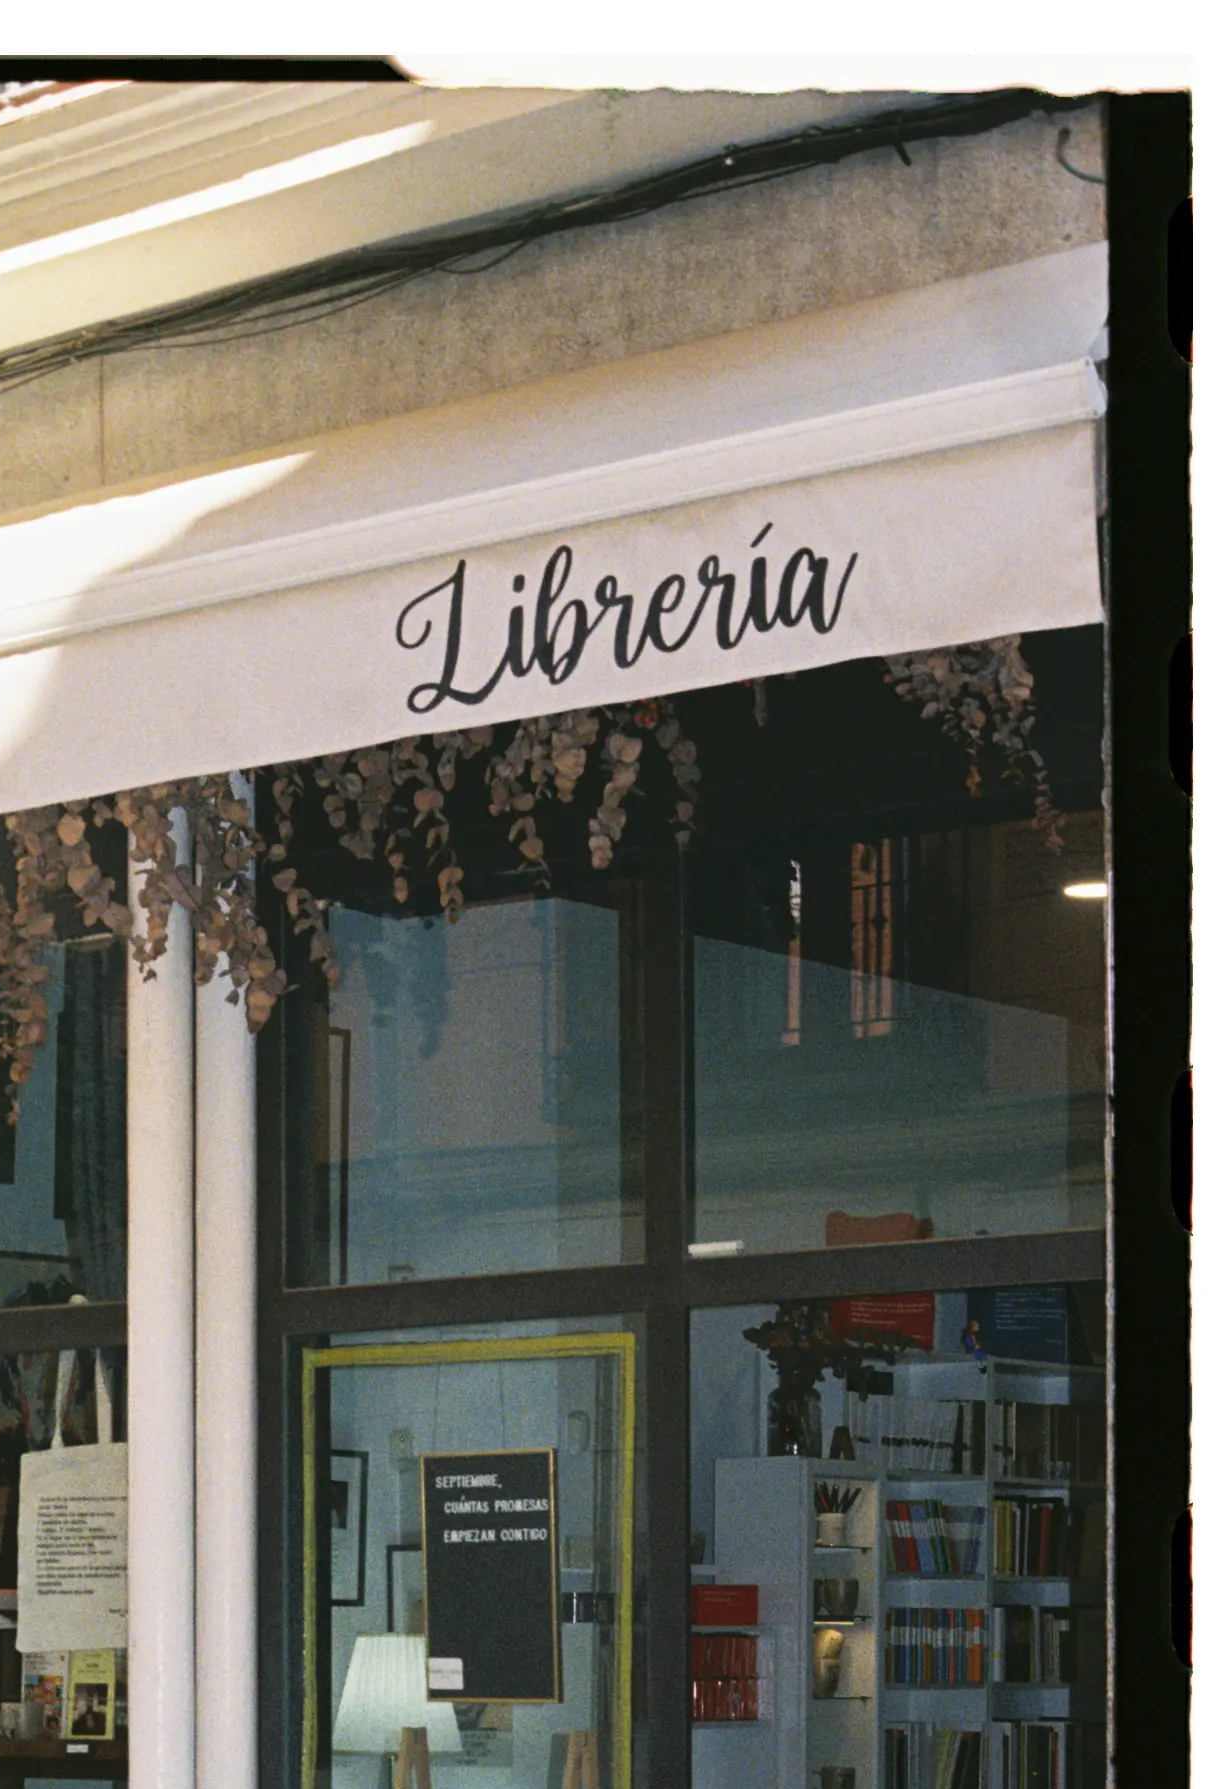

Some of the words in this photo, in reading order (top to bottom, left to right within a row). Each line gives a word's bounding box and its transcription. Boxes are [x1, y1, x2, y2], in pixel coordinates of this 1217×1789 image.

[396, 523, 858, 714] Librería
[435, 1474, 502, 1489] SEPTIEMBRE,
[444, 1494, 490, 1514] CUÁNTAS
[494, 1499, 549, 1513] PROMESAS
[444, 1529, 496, 1543] EMPIEZAN
[500, 1528, 548, 1541] CONTIGO
